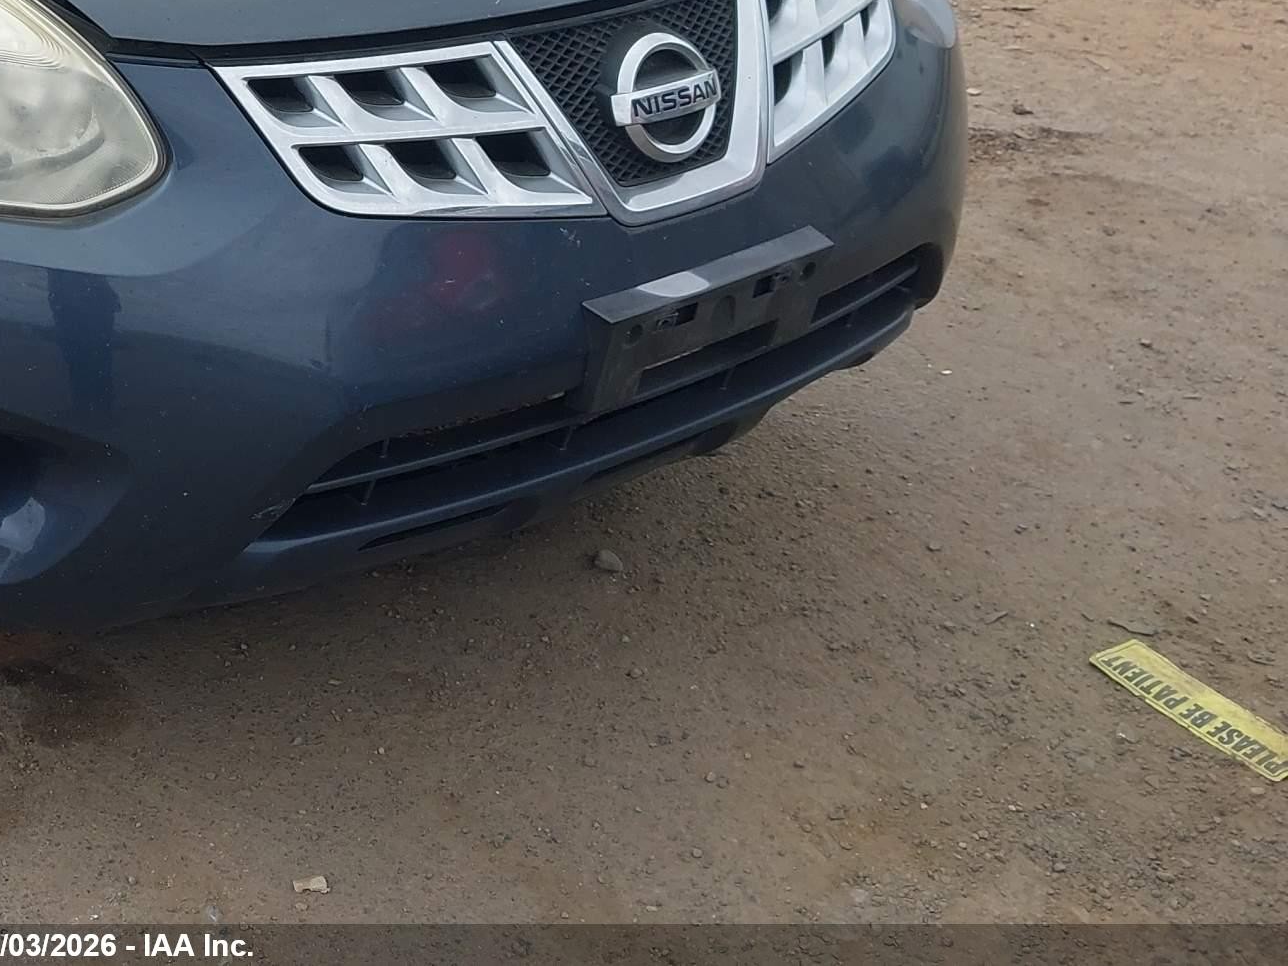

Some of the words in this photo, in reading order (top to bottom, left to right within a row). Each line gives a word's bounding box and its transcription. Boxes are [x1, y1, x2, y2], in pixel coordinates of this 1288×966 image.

[630, 79, 718, 117] NISSAN
[1101, 655, 1189, 710] PATIENT
[1178, 703, 1217, 729] BE
[1206, 720, 1288, 775] PLEASE
